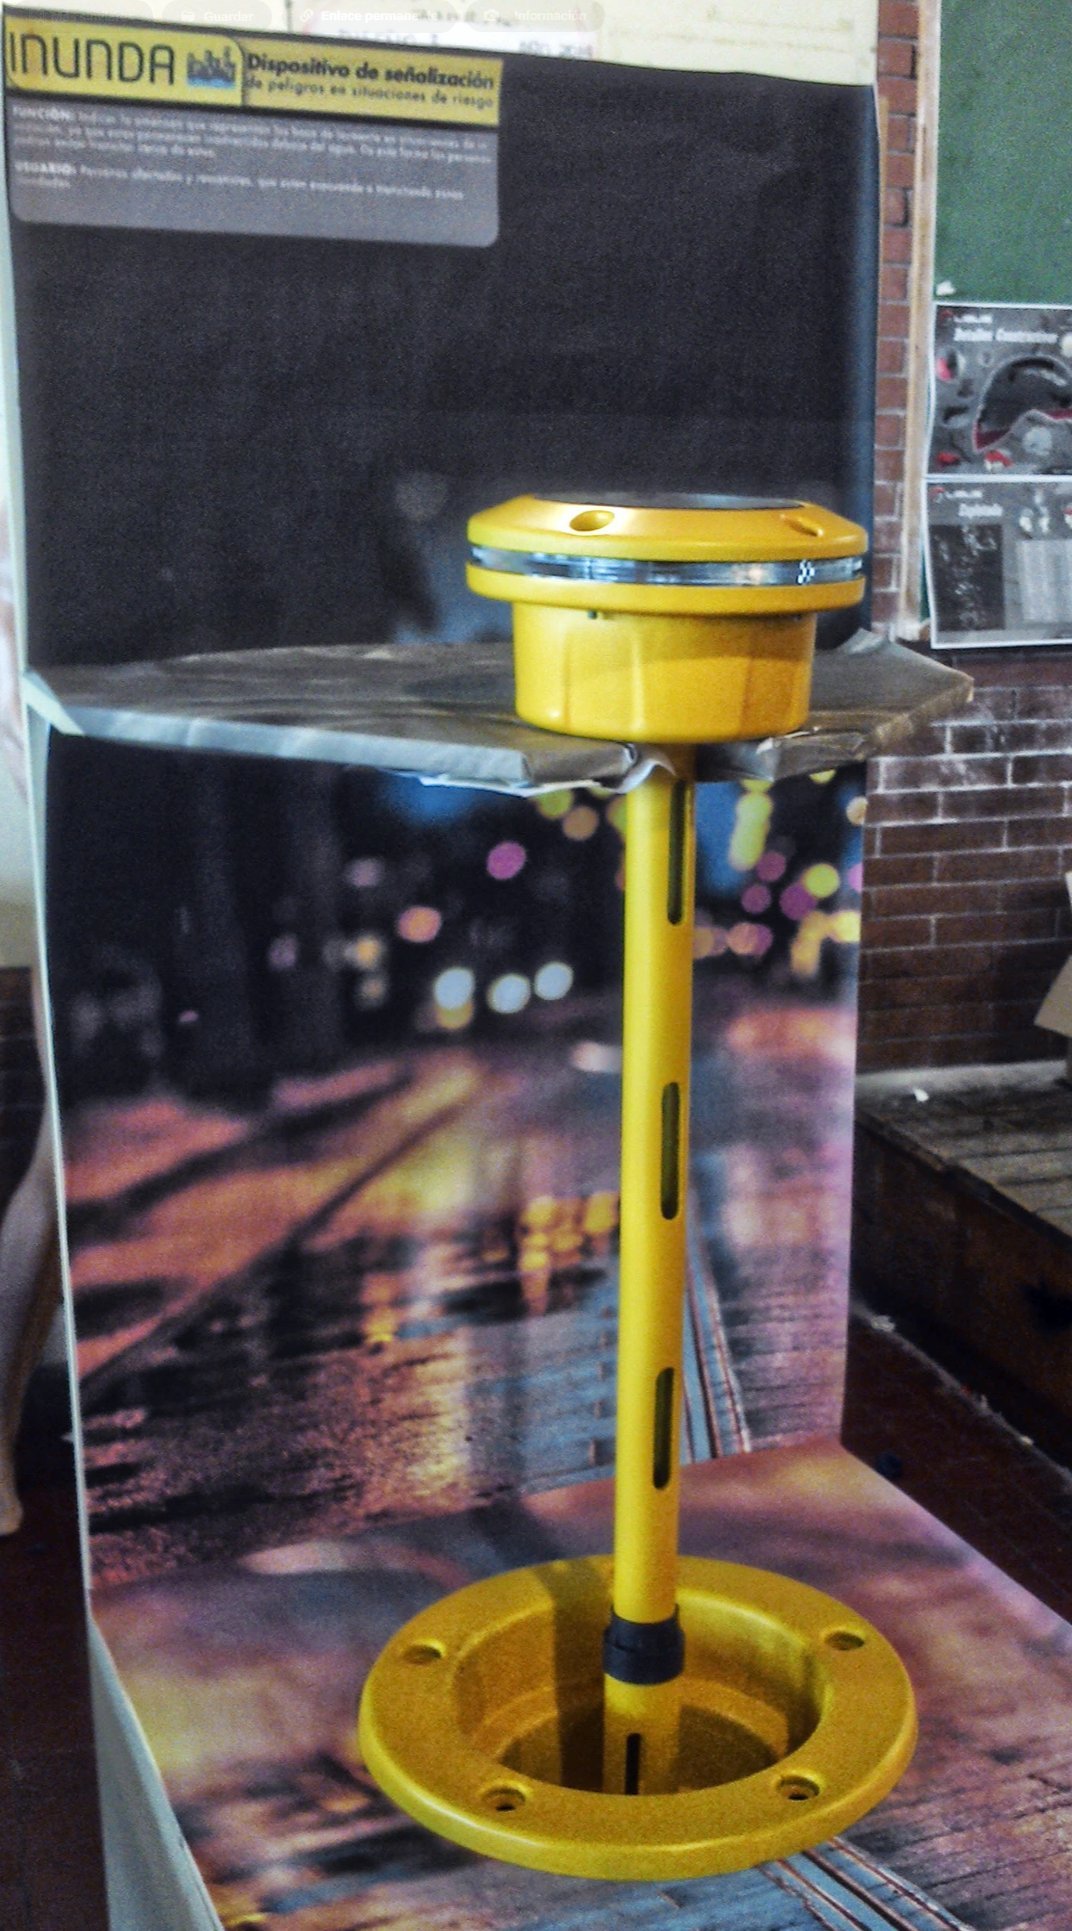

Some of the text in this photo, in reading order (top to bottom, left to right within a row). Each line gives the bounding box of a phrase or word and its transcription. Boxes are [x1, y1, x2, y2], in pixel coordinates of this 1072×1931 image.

[247, 53, 494, 90] Dispositivo de señalización
